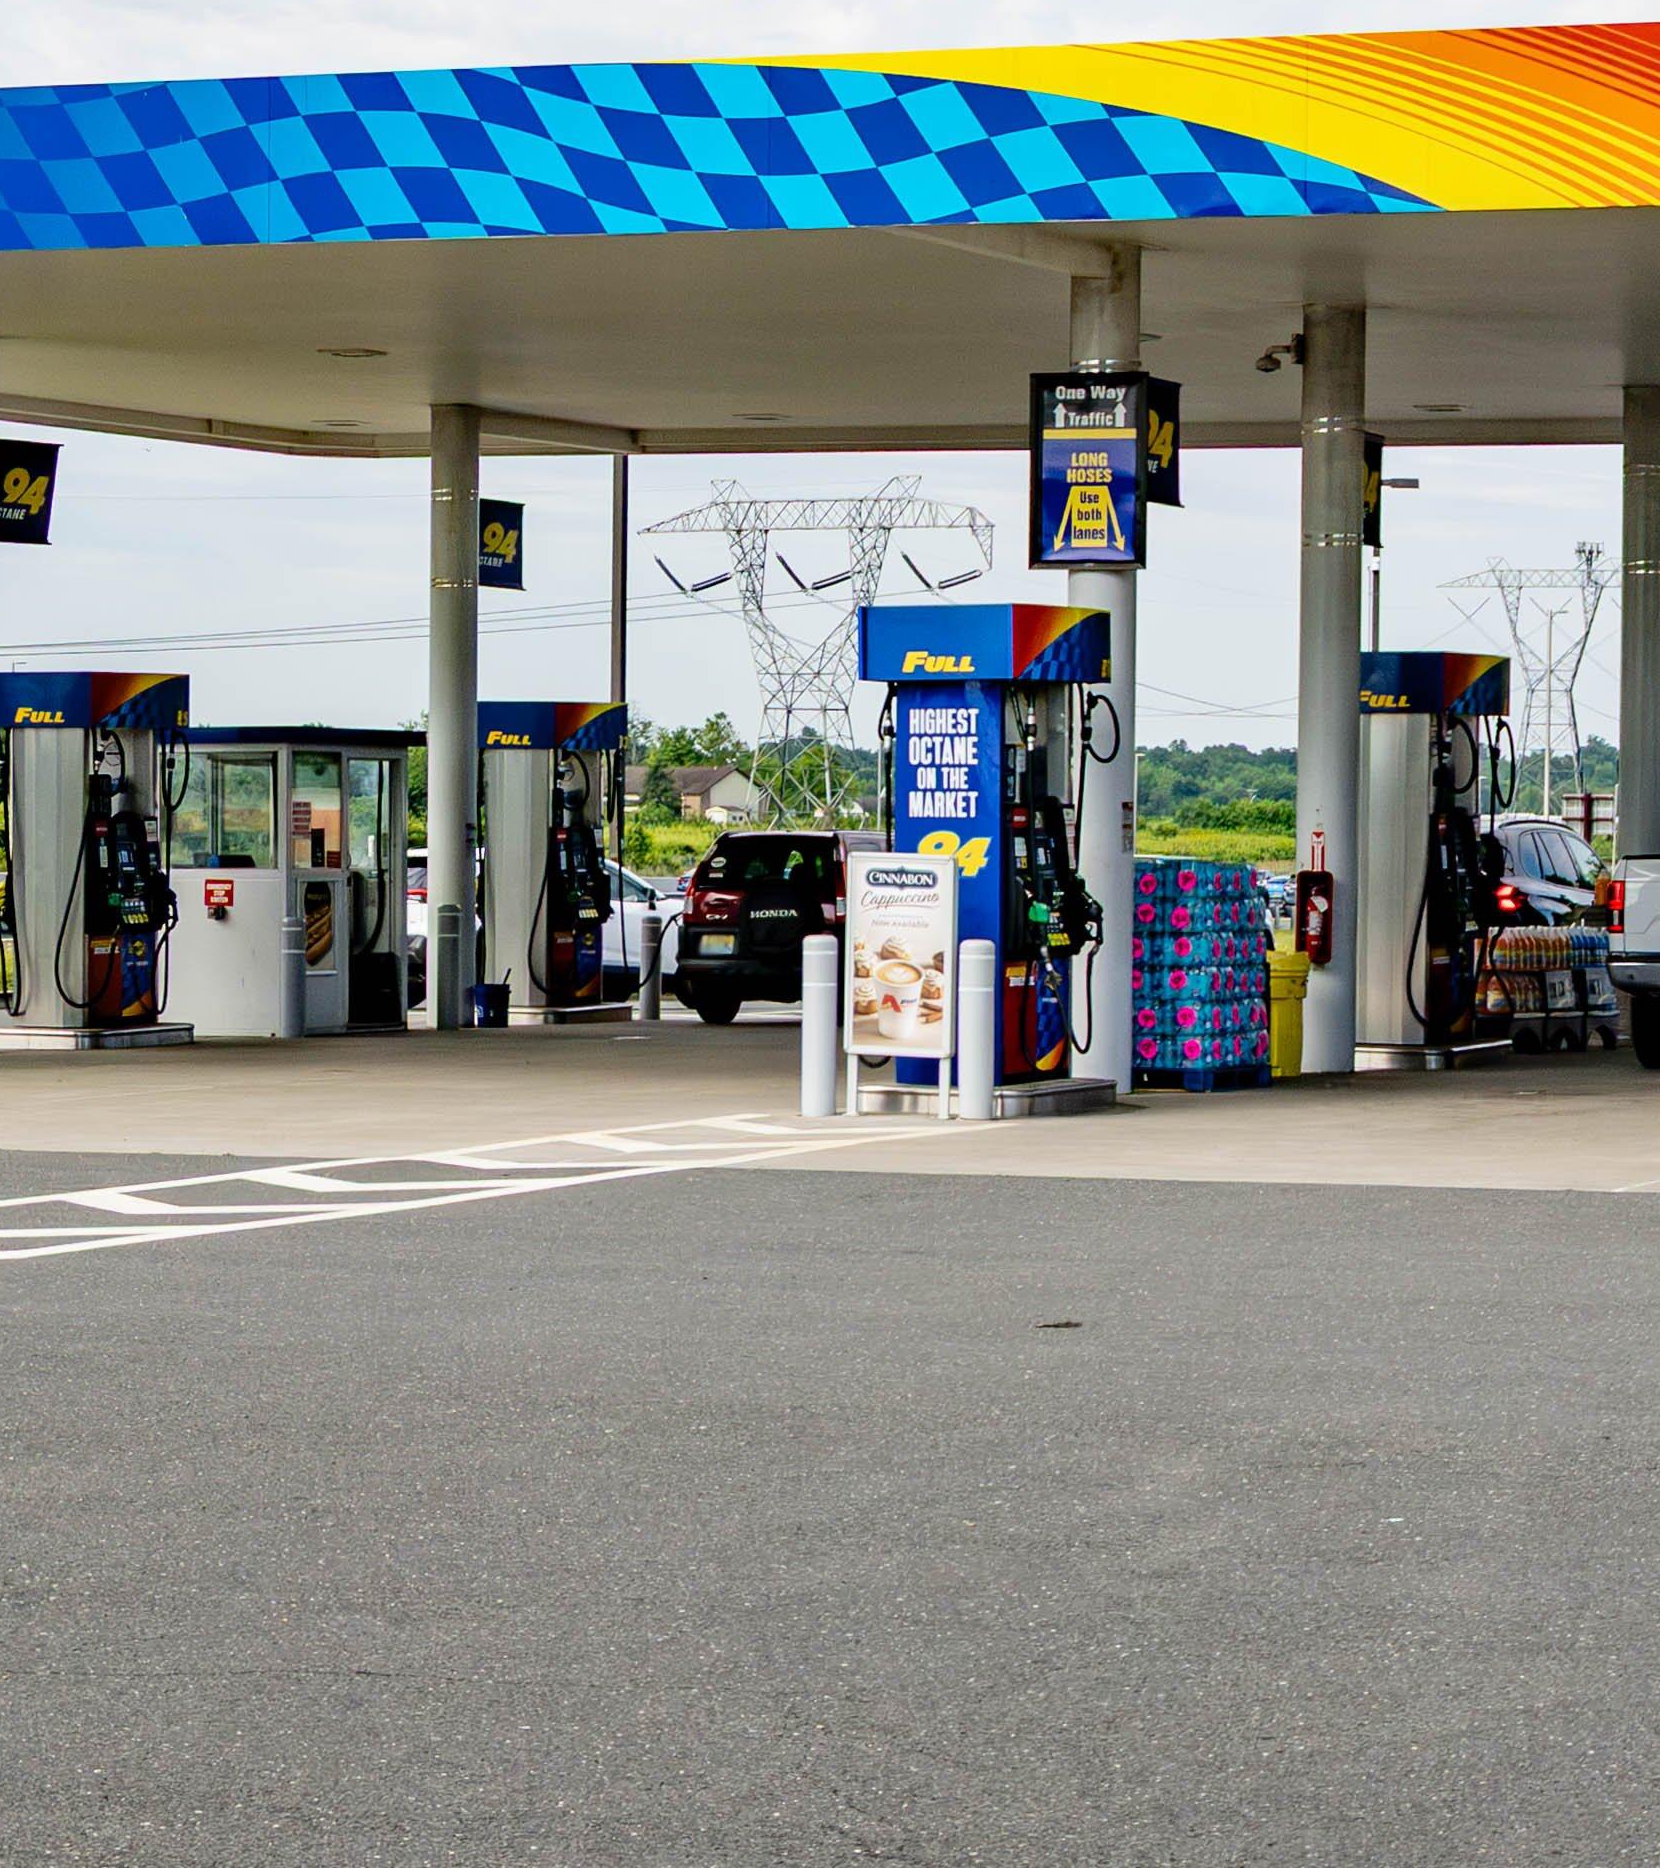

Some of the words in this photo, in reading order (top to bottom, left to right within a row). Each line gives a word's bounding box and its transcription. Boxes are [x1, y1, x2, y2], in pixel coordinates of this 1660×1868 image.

[1055, 385, 1085, 399] One
[1090, 385, 1126, 402] Way
[1067, 411, 1114, 426] Traffic
[1071, 452, 1108, 467] LONG
[1066, 468, 1112, 483] HOSES
[3, 467, 49, 515] 94
[1364, 460, 1380, 513] 4
[1080, 491, 1099, 503] Use
[1077, 507, 1102, 521] both
[1073, 526, 1105, 540] lanes
[482, 522, 519, 563] 94
[478, 556, 504, 567] CTANE
[902, 651, 976, 673] FULL
[1359, 690, 1411, 708] FULL
[14, 707, 66, 723] FULL
[908, 708, 979, 734] HIGHEST
[486, 730, 532, 746] FULL
[908, 736, 979, 765] OCTANE
[917, 767, 937, 790] ON
[941, 767, 969, 790] THE
[908, 791, 979, 818] MARKET
[917, 830, 993, 877] 94
[868, 871, 934, 886] CINNABON
[861, 891, 940, 910] Cappuccino
[750, 909, 798, 919] HONDA
